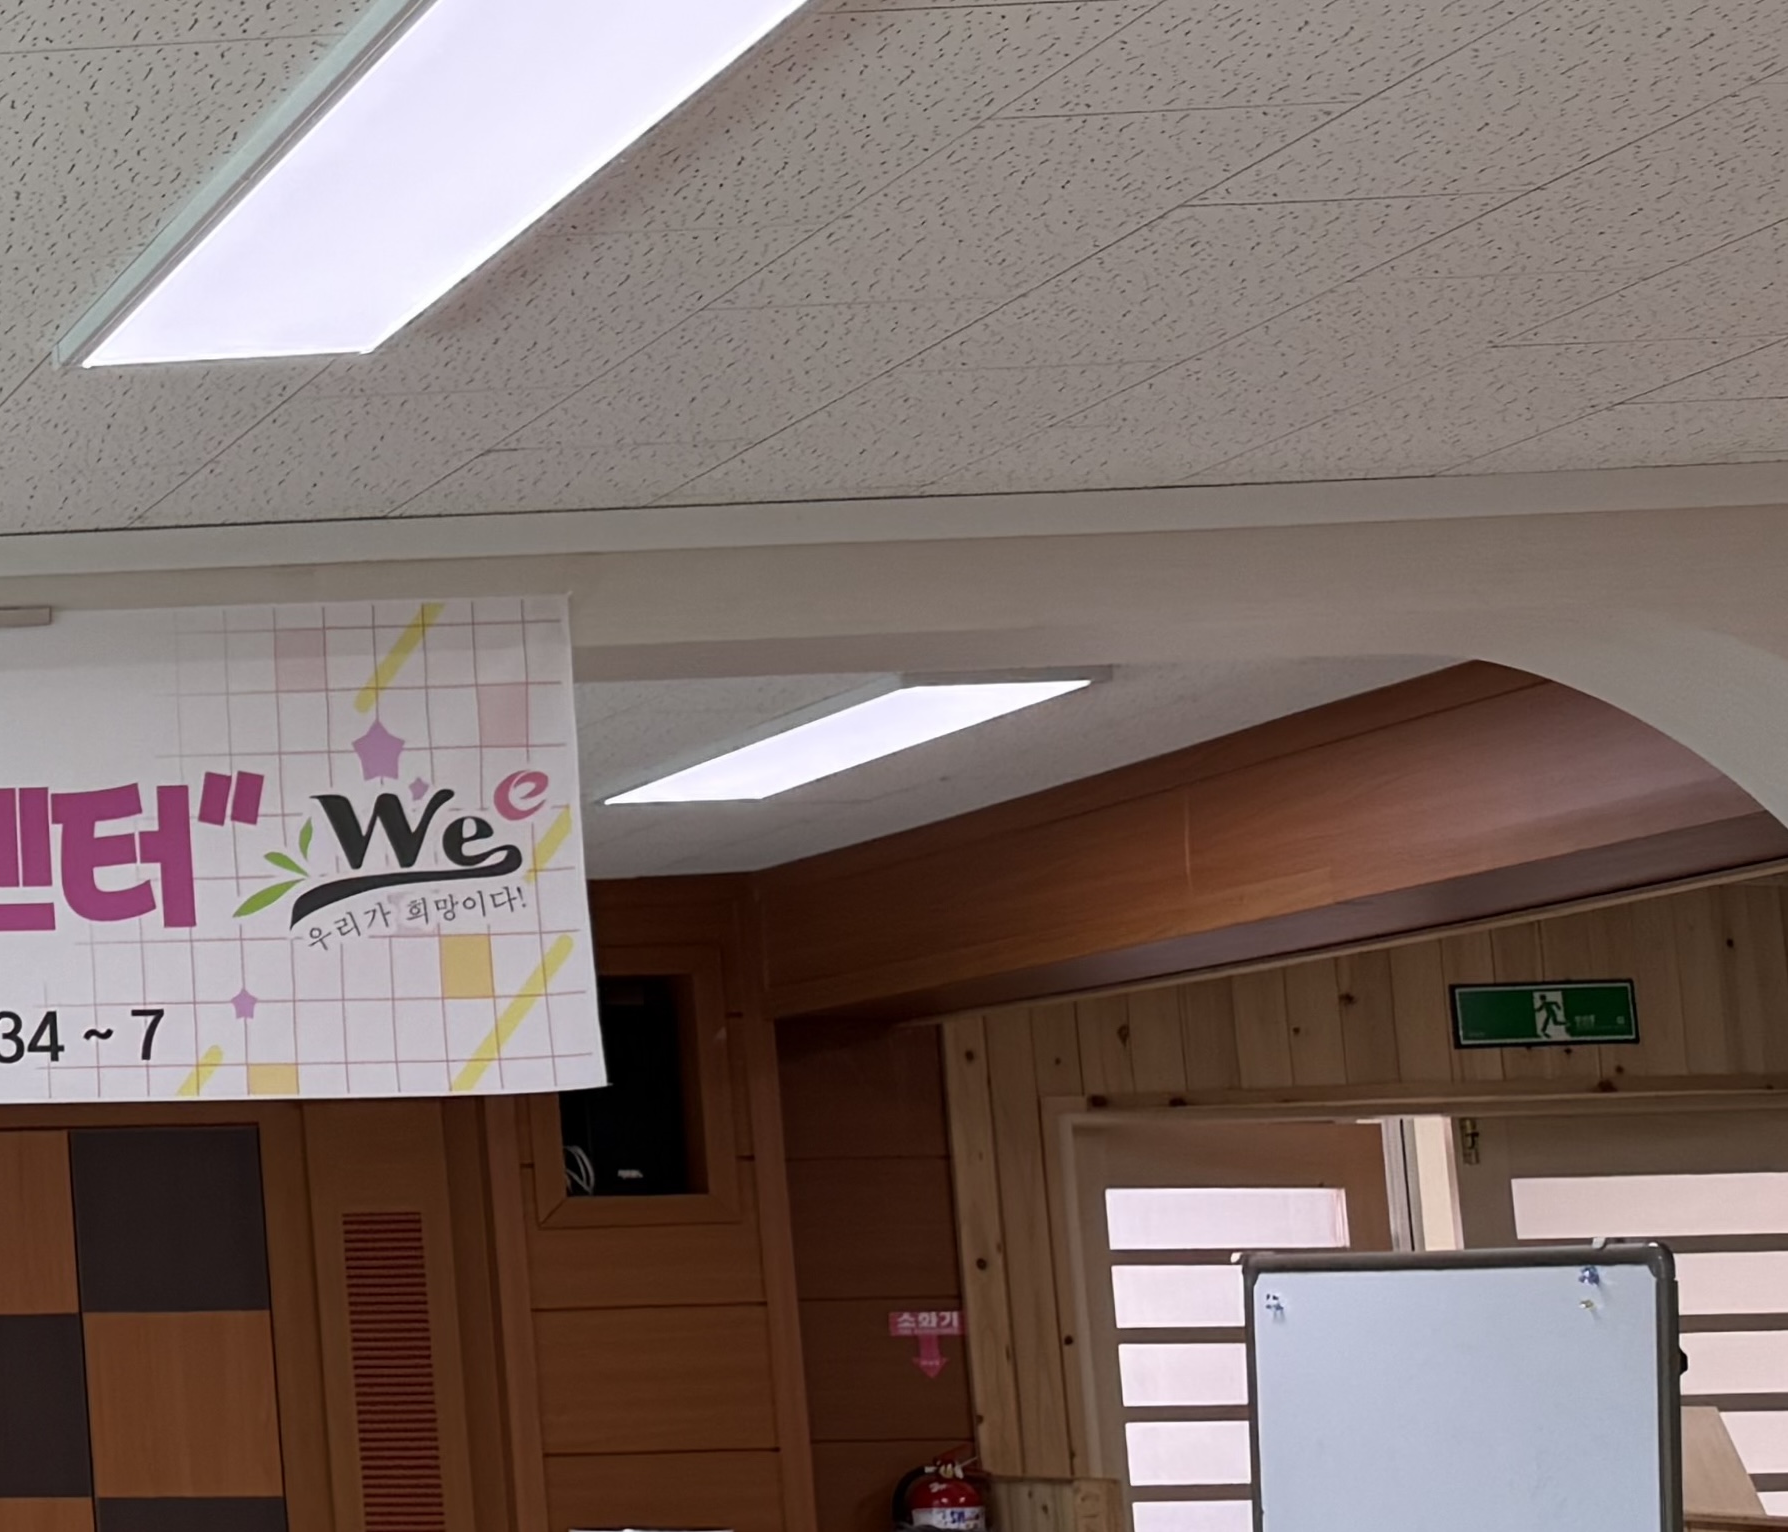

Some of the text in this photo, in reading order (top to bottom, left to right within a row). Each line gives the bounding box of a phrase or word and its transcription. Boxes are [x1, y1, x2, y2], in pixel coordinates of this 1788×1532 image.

[307, 886, 528, 951] 우리가 희망이다!
[897, 1312, 959, 1329] 소화기
